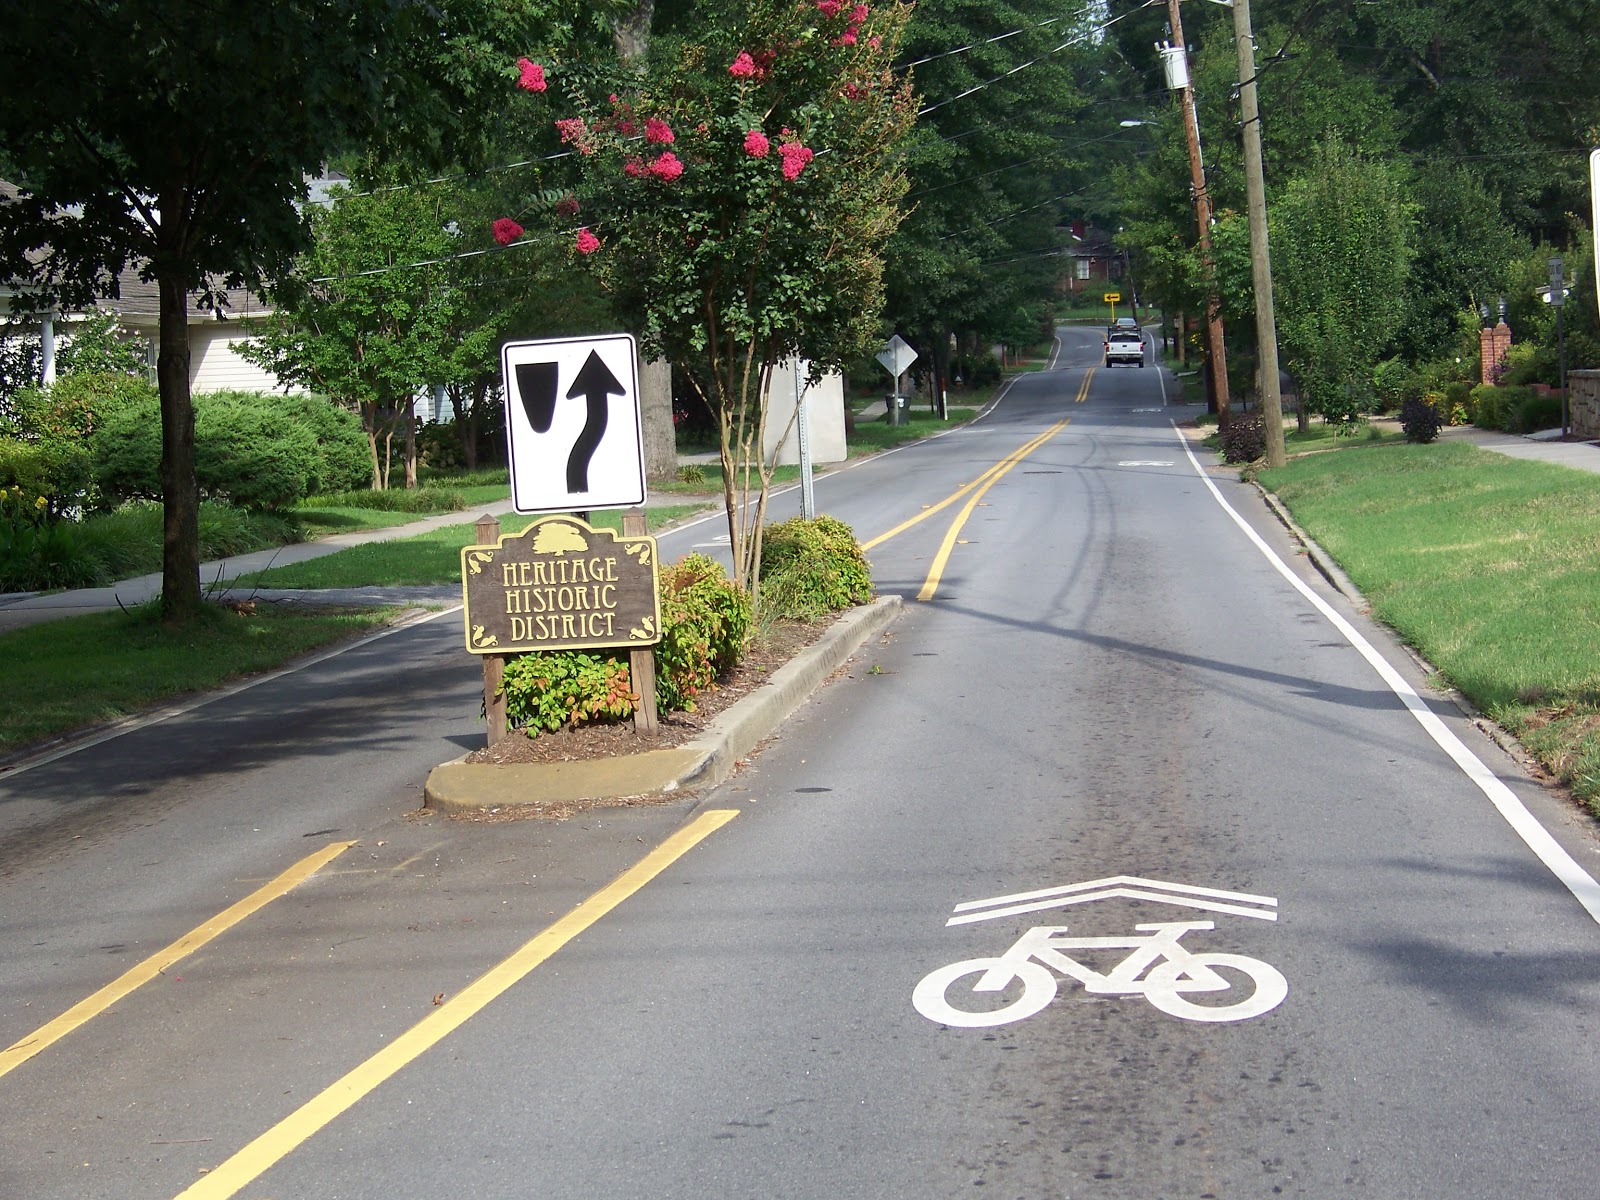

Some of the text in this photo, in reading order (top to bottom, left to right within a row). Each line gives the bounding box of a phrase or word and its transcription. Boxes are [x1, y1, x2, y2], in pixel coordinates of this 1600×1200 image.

[502, 558, 619, 587] HERITAGE
[505, 584, 618, 613] HISTORIC
[510, 612, 616, 641] DISTRICT
